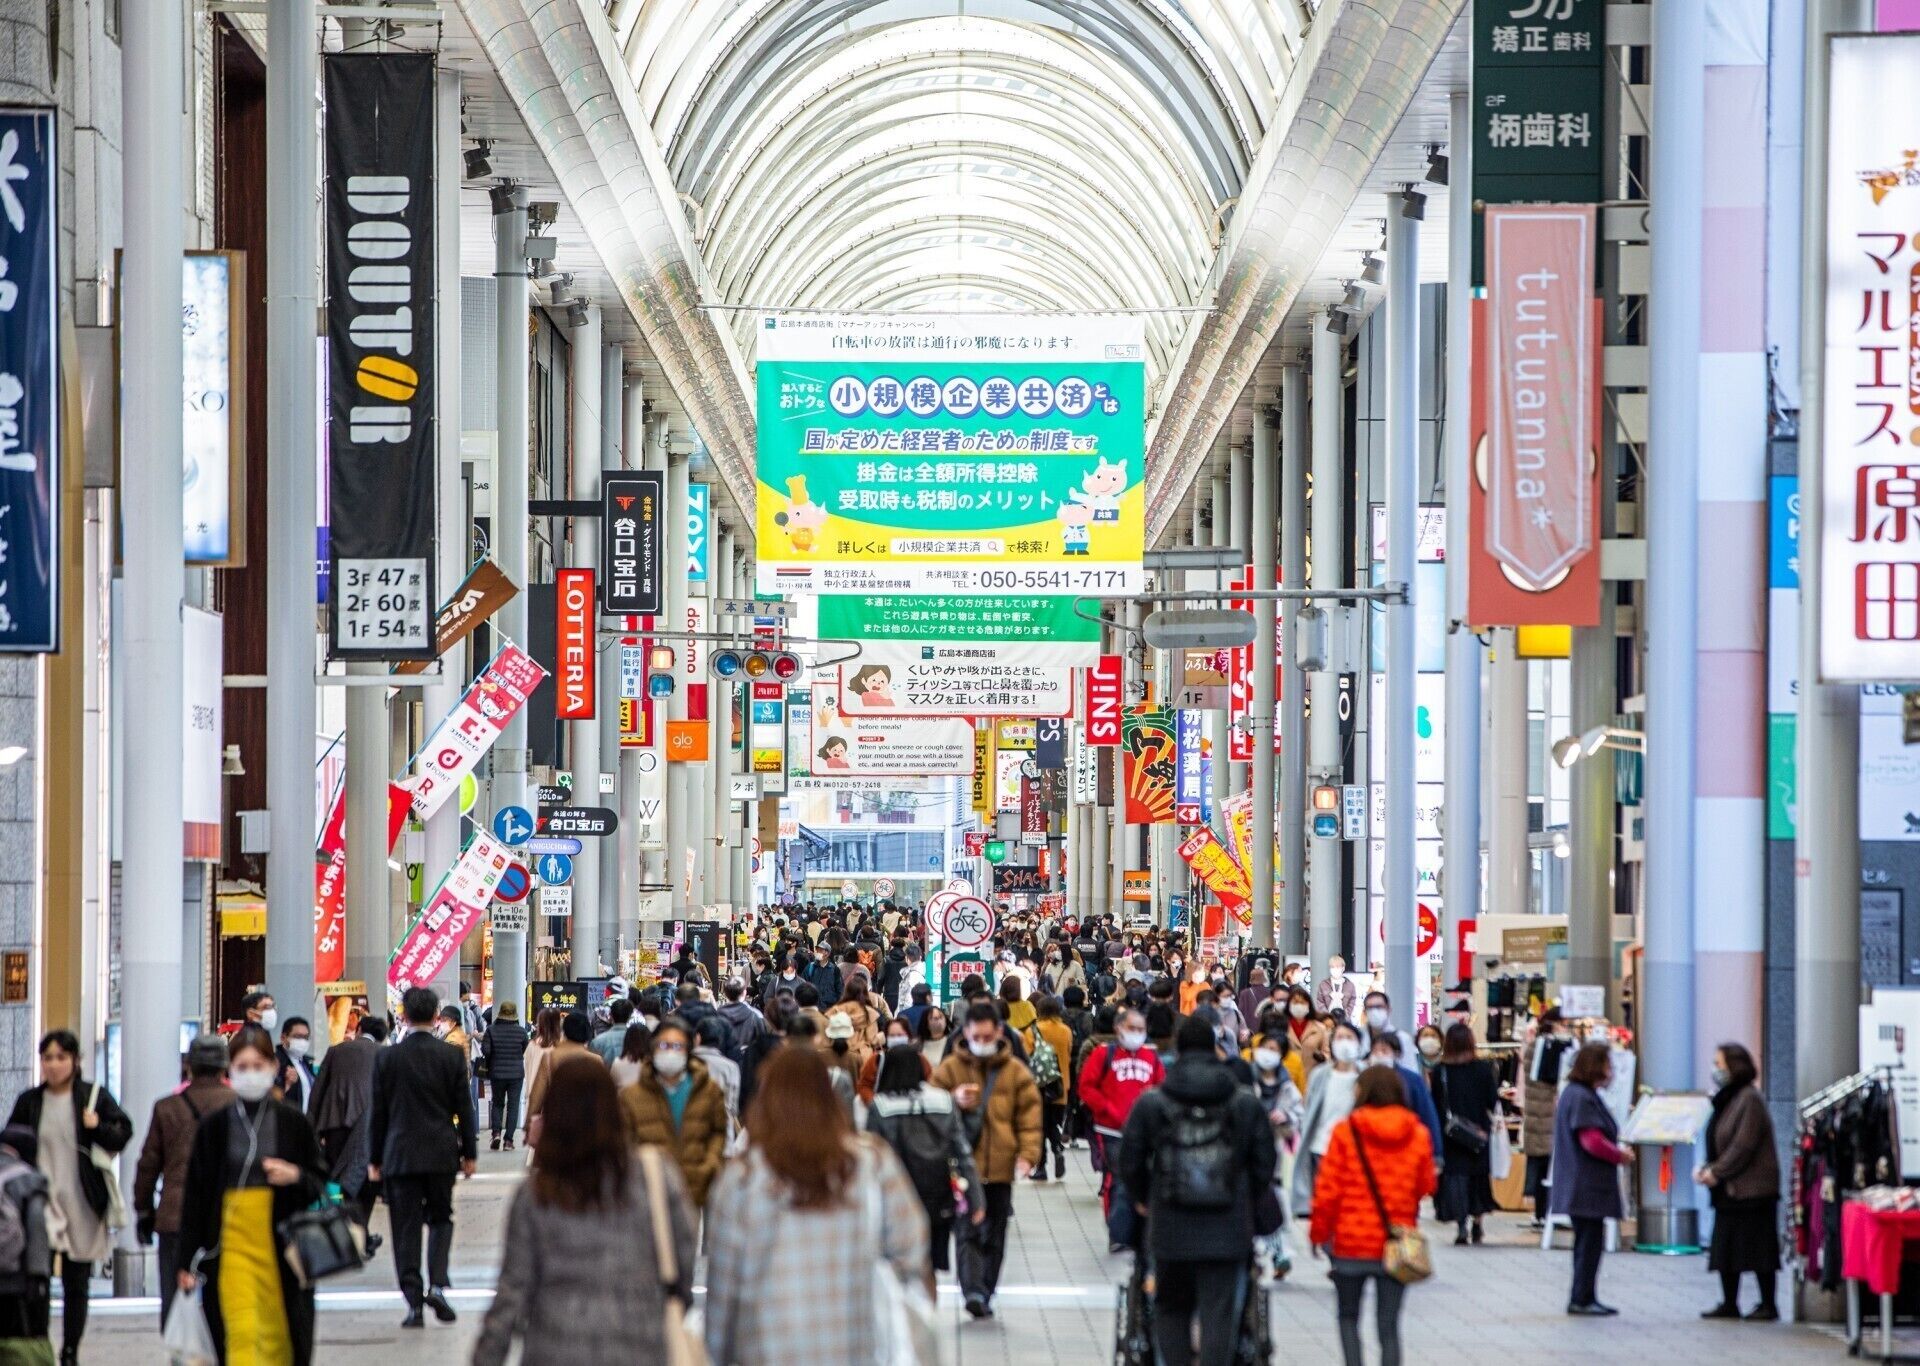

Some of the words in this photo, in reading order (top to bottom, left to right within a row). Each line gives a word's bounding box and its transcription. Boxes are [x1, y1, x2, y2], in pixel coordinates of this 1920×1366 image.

[1492, 25, 1592, 53] 矯正歯科
[1488, 112, 1592, 148] 柄歯科
[346, 176, 420, 443] DOUTOR
[805, 430, 1097, 452] 国が定めた経営者のための制度です
[856, 462, 1039, 484] 掛金は全額所得控除
[838, 489, 1056, 511] 受取時も税制のメリット
[837, 540, 887, 555] 詳しくは
[898, 540, 982, 554] 小規模企業共済
[613, 517, 637, 598] 谷口宝石
[823, 569, 876, 578] 独立行政法人
[980, 570, 1127, 589] 050-5541-7171
[823, 579, 912, 589] 中小企業基盤整備機構
[951, 580, 970, 588] TEL
[565, 574, 585, 713] LOTTERIA
[938, 649, 997, 659] 広島本通商店街
[906, 678, 1058, 692] ティッシュ等で口と鼻を覆ったり
[1183, 691, 1204, 705] 1F
[672, 731, 693, 747] glo
[831, 781, 881, 789] 0120-57-2418
[1178, 807, 1201, 822] くす
[549, 819, 605, 832] 谷口宝石
